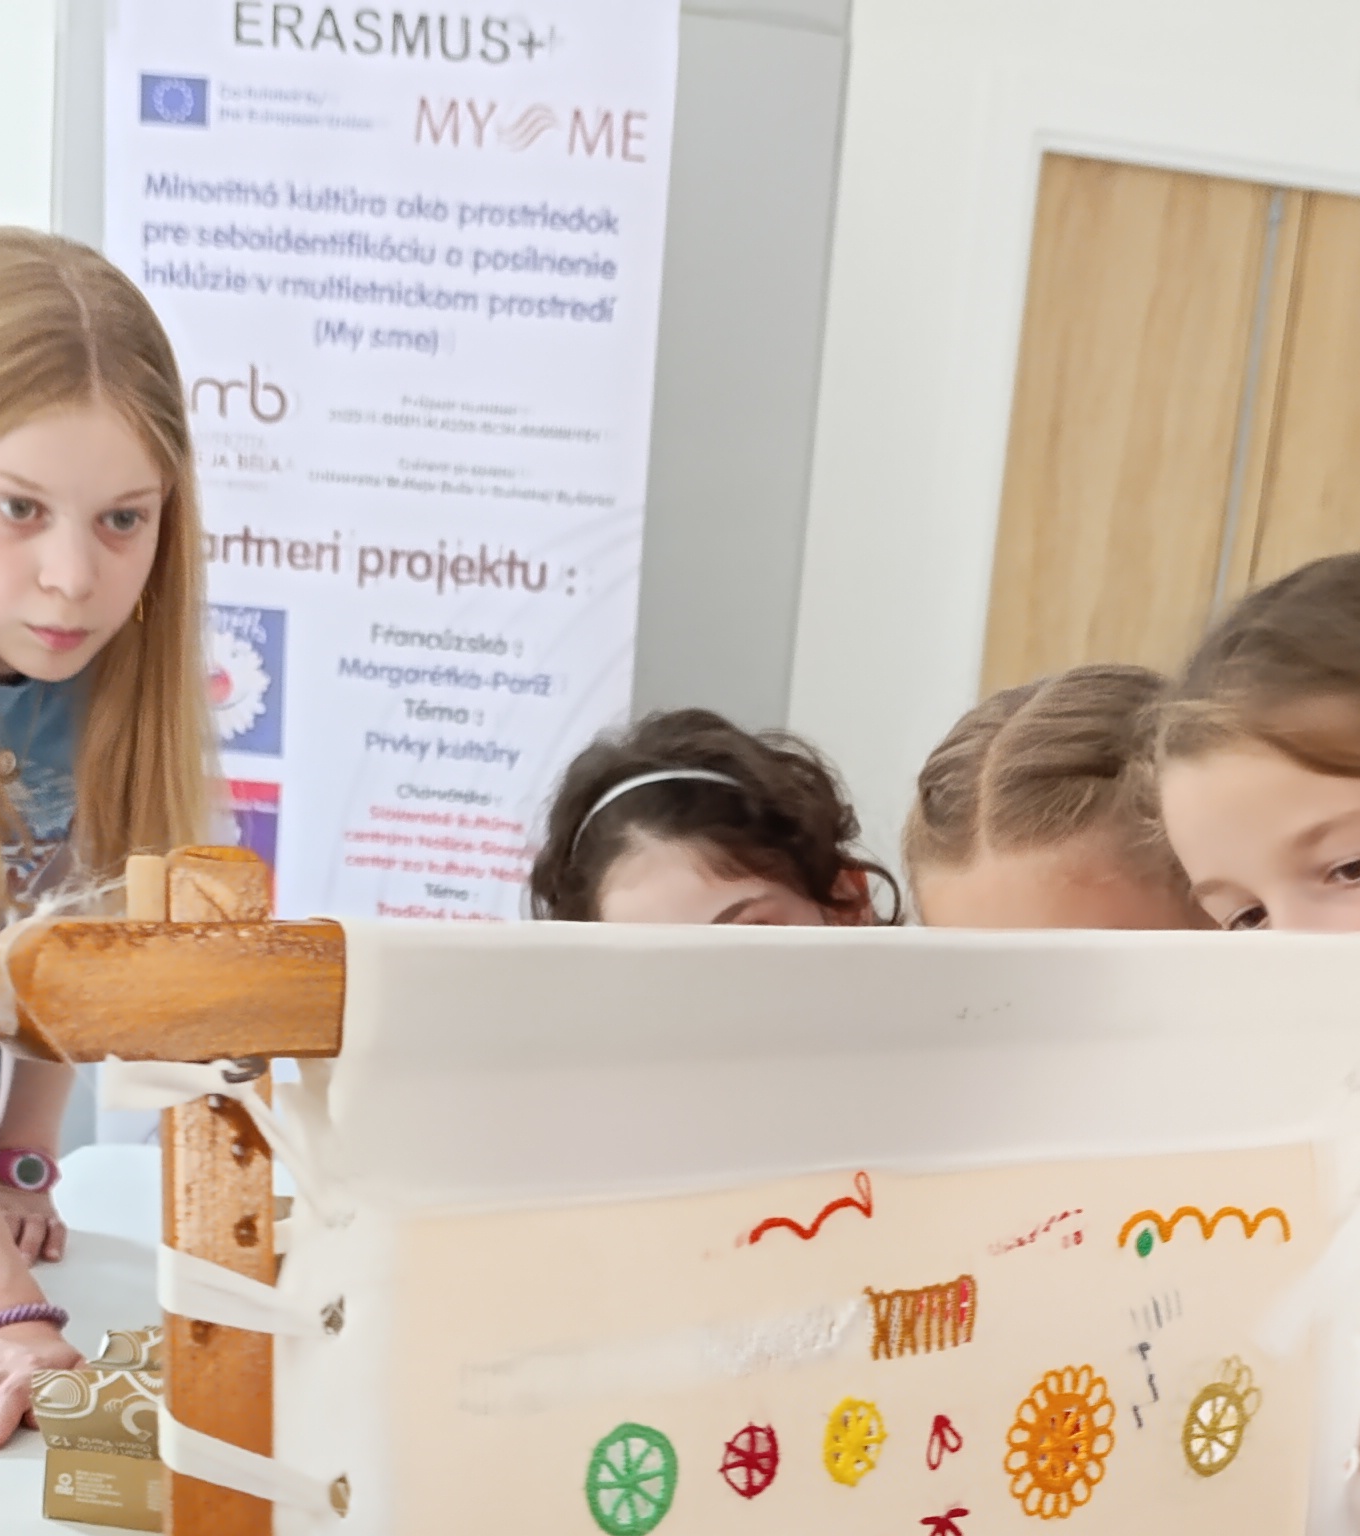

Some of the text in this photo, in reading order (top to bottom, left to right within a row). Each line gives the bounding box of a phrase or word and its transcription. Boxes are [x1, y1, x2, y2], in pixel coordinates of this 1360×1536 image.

[233, 1, 546, 65] ERASMUS+
[415, 95, 647, 163] MY ME
[143, 221, 188, 250] pre
[445, 246, 463, 268] a
[396, 193, 449, 222] ako
[458, 201, 619, 235] prostriedok
[256, 273, 272, 294] v
[192, 361, 287, 424] mb
[204, 525, 340, 573] artneri
[357, 538, 547, 596] projektu
